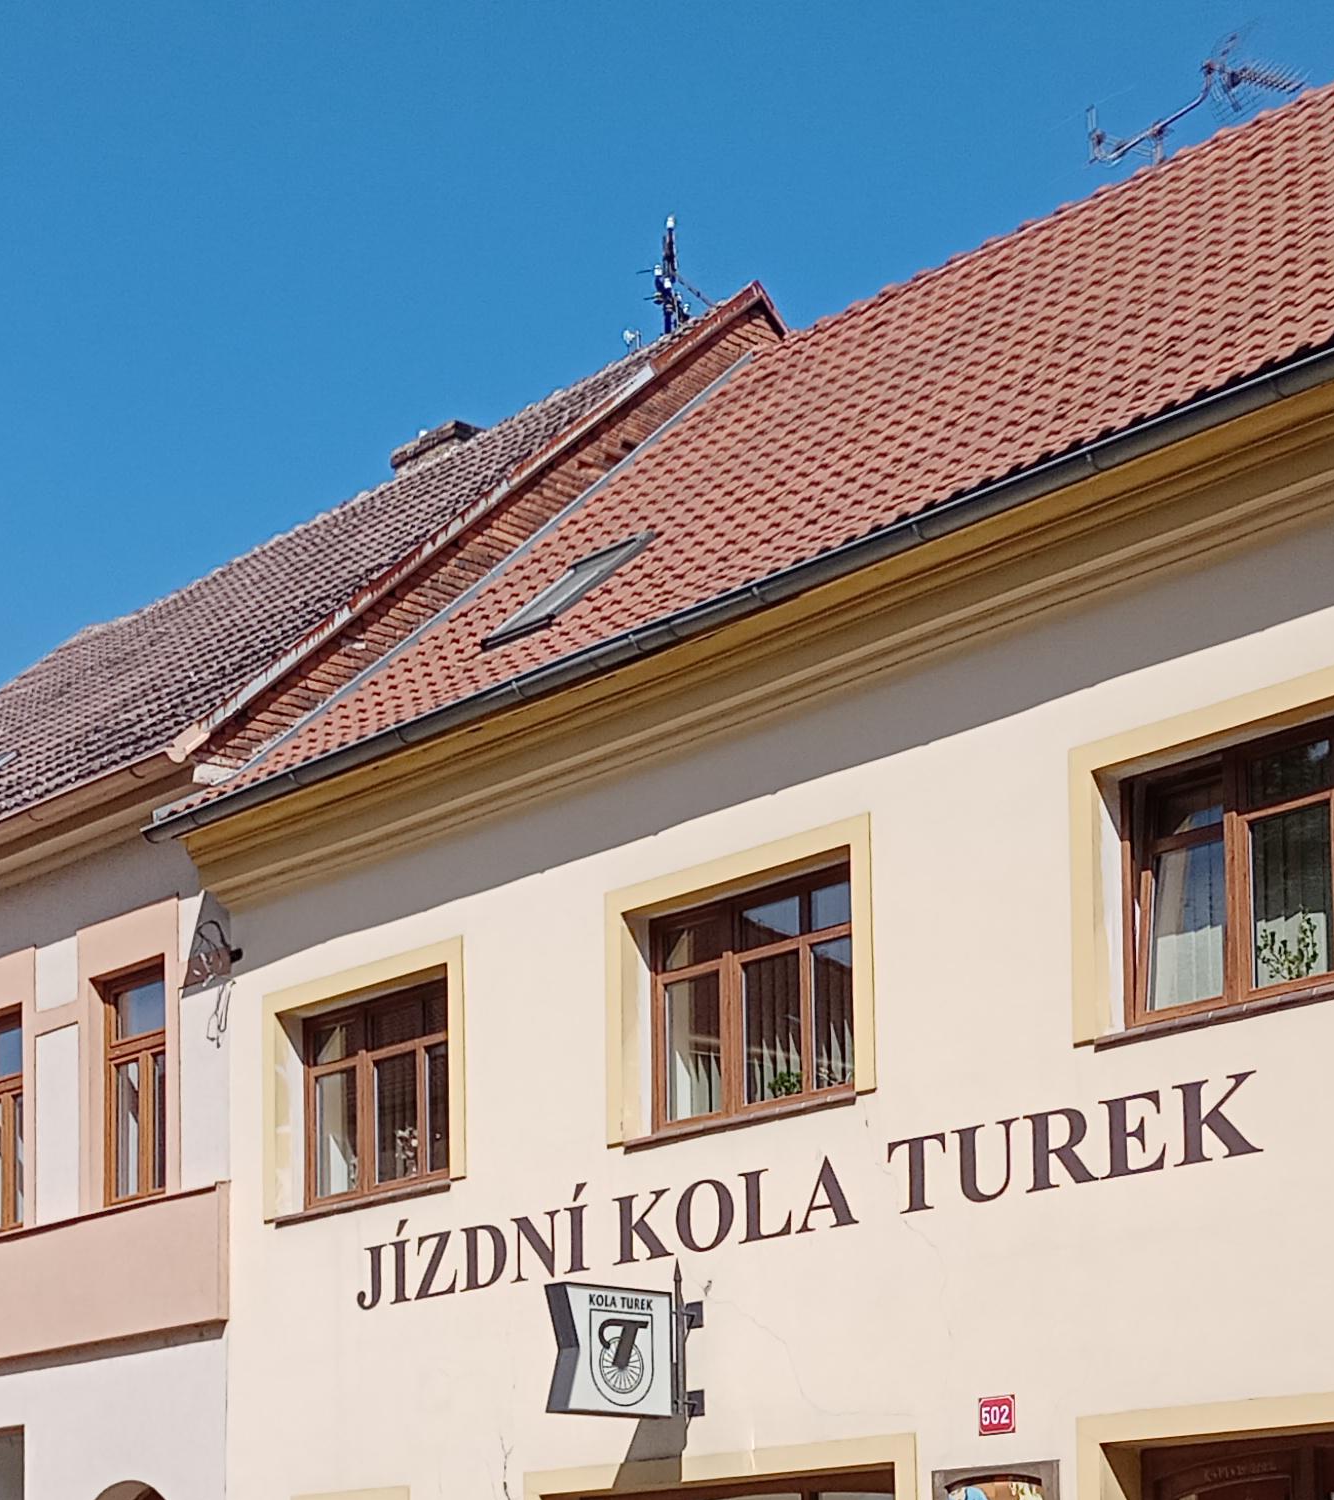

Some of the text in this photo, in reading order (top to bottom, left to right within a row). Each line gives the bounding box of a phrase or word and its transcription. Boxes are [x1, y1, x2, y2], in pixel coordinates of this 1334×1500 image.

[357, 1069, 1264, 1311] JÍZDNÍ KOLA TUREK
[588, 1293, 654, 1312] KOLA TUREK
[981, 1404, 1010, 1426] 502
